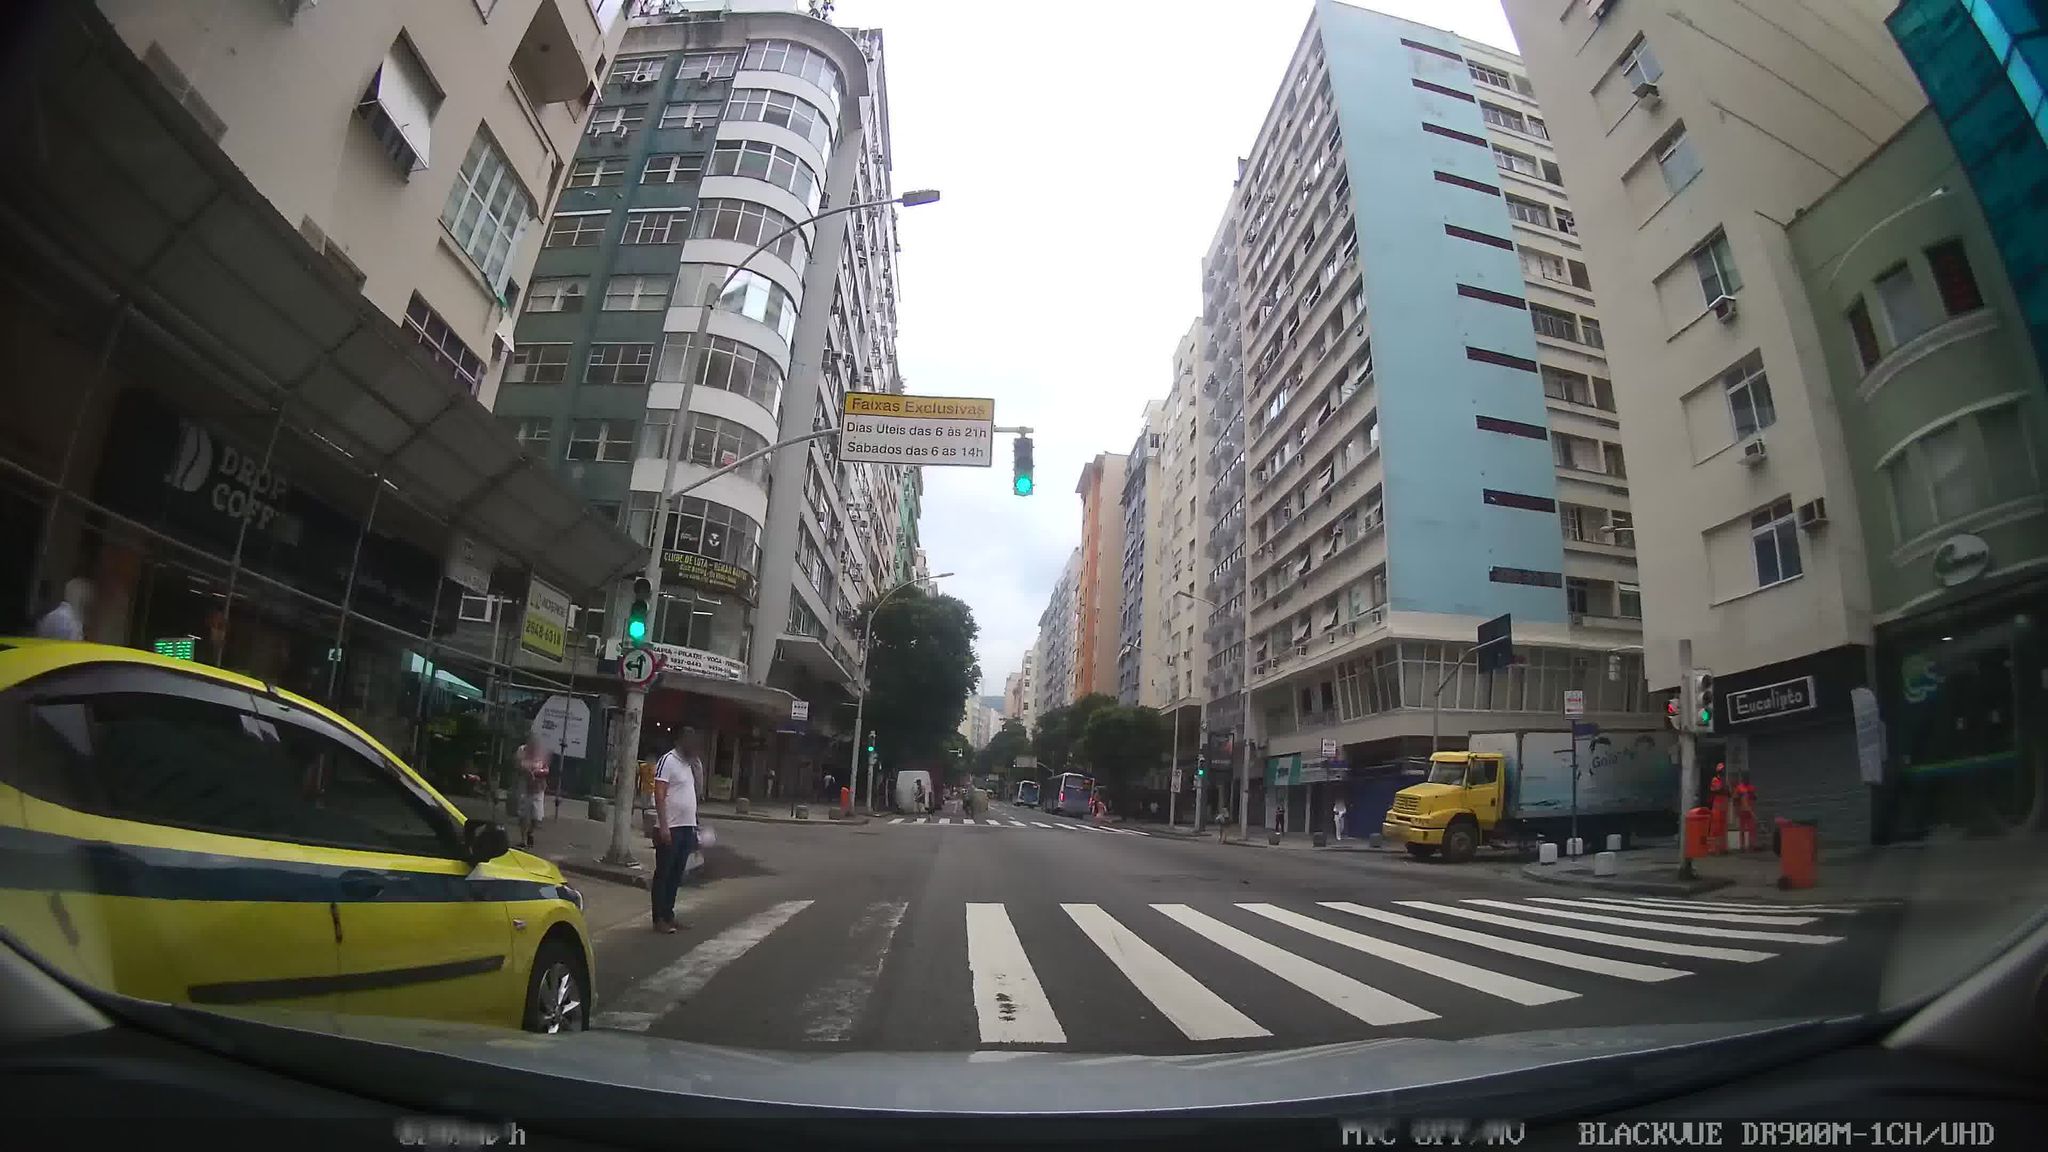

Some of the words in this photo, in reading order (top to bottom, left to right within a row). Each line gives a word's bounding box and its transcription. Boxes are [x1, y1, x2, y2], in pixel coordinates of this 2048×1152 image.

[852, 397, 900, 412] Faixas
[905, 401, 985, 415] Exclusivas
[847, 421, 872, 433] Dias
[909, 426, 932, 436] das
[935, 426, 943, 437] 6
[964, 426, 987, 438] 21h
[905, 445, 928, 456] das
[931, 446, 939, 457] 6
[961, 447, 984, 457] 14h
[221, 446, 287, 500] DROP
[212, 483, 284, 530] COFF
[1735, 687, 1803, 715] Eucalipto
